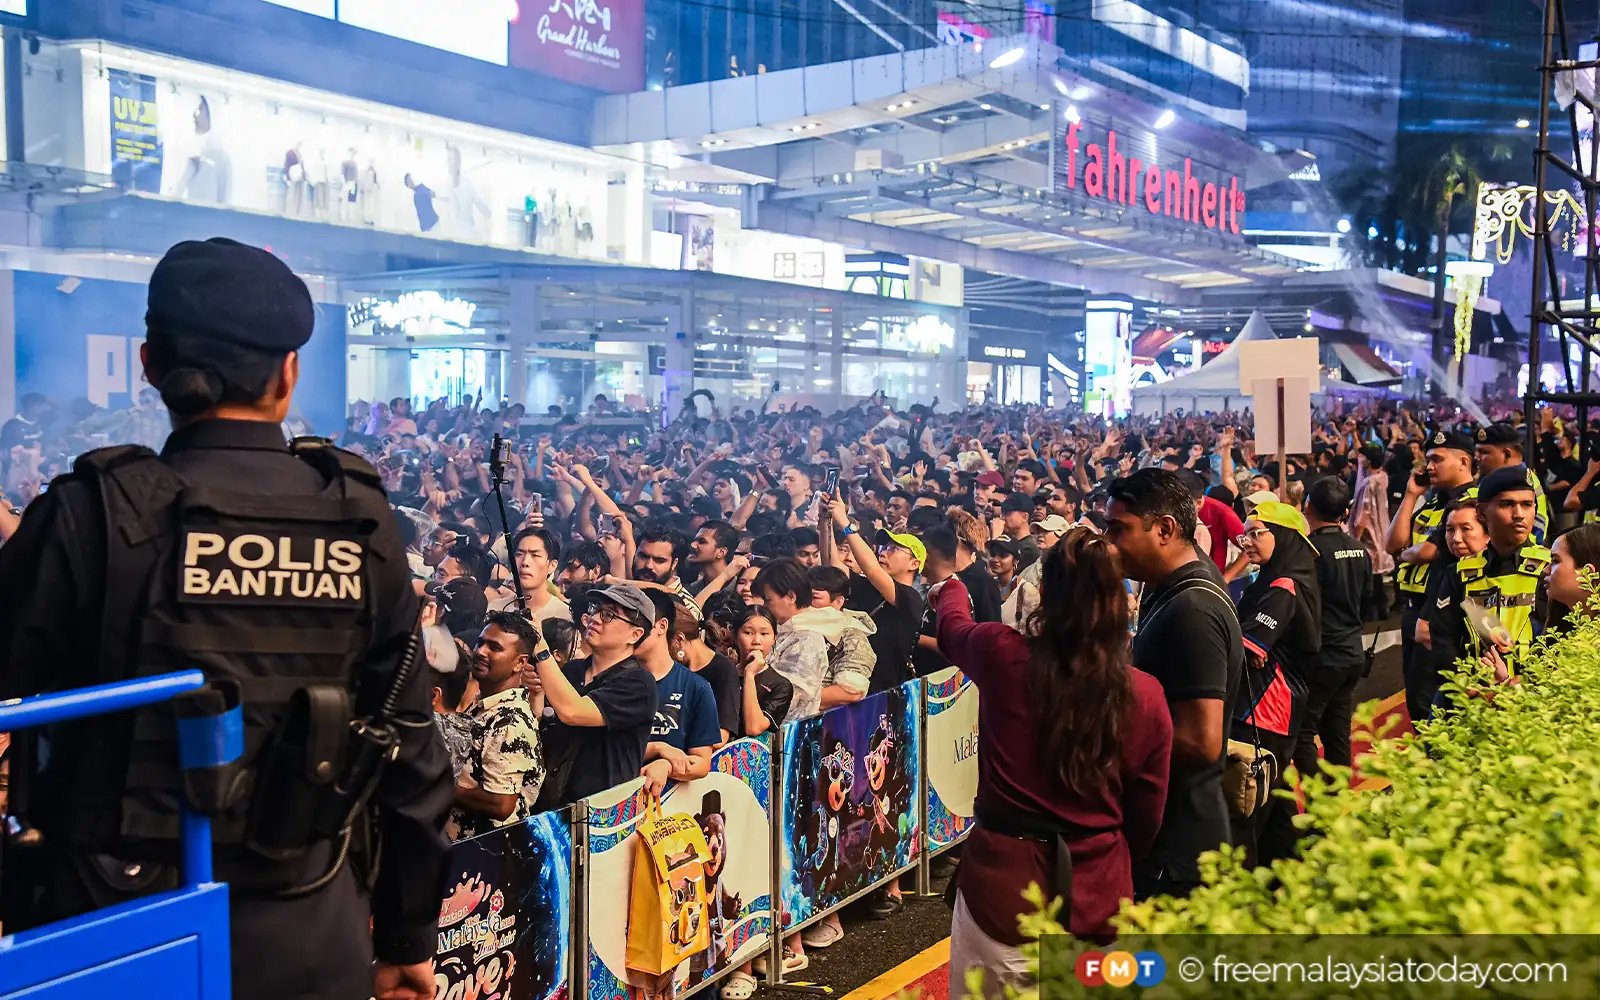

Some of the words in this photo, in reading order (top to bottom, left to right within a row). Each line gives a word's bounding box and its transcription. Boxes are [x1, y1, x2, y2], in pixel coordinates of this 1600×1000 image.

[537, 14, 577, 46] Grand
[1066, 118, 1240, 235] fahrenheit
[184, 532, 363, 574] POLIS
[1334, 549, 1364, 560] SECURITY
[183, 567, 362, 600] BANTUAN
[1255, 612, 1278, 630] MEDIC
[953, 731, 979, 764] Mala
